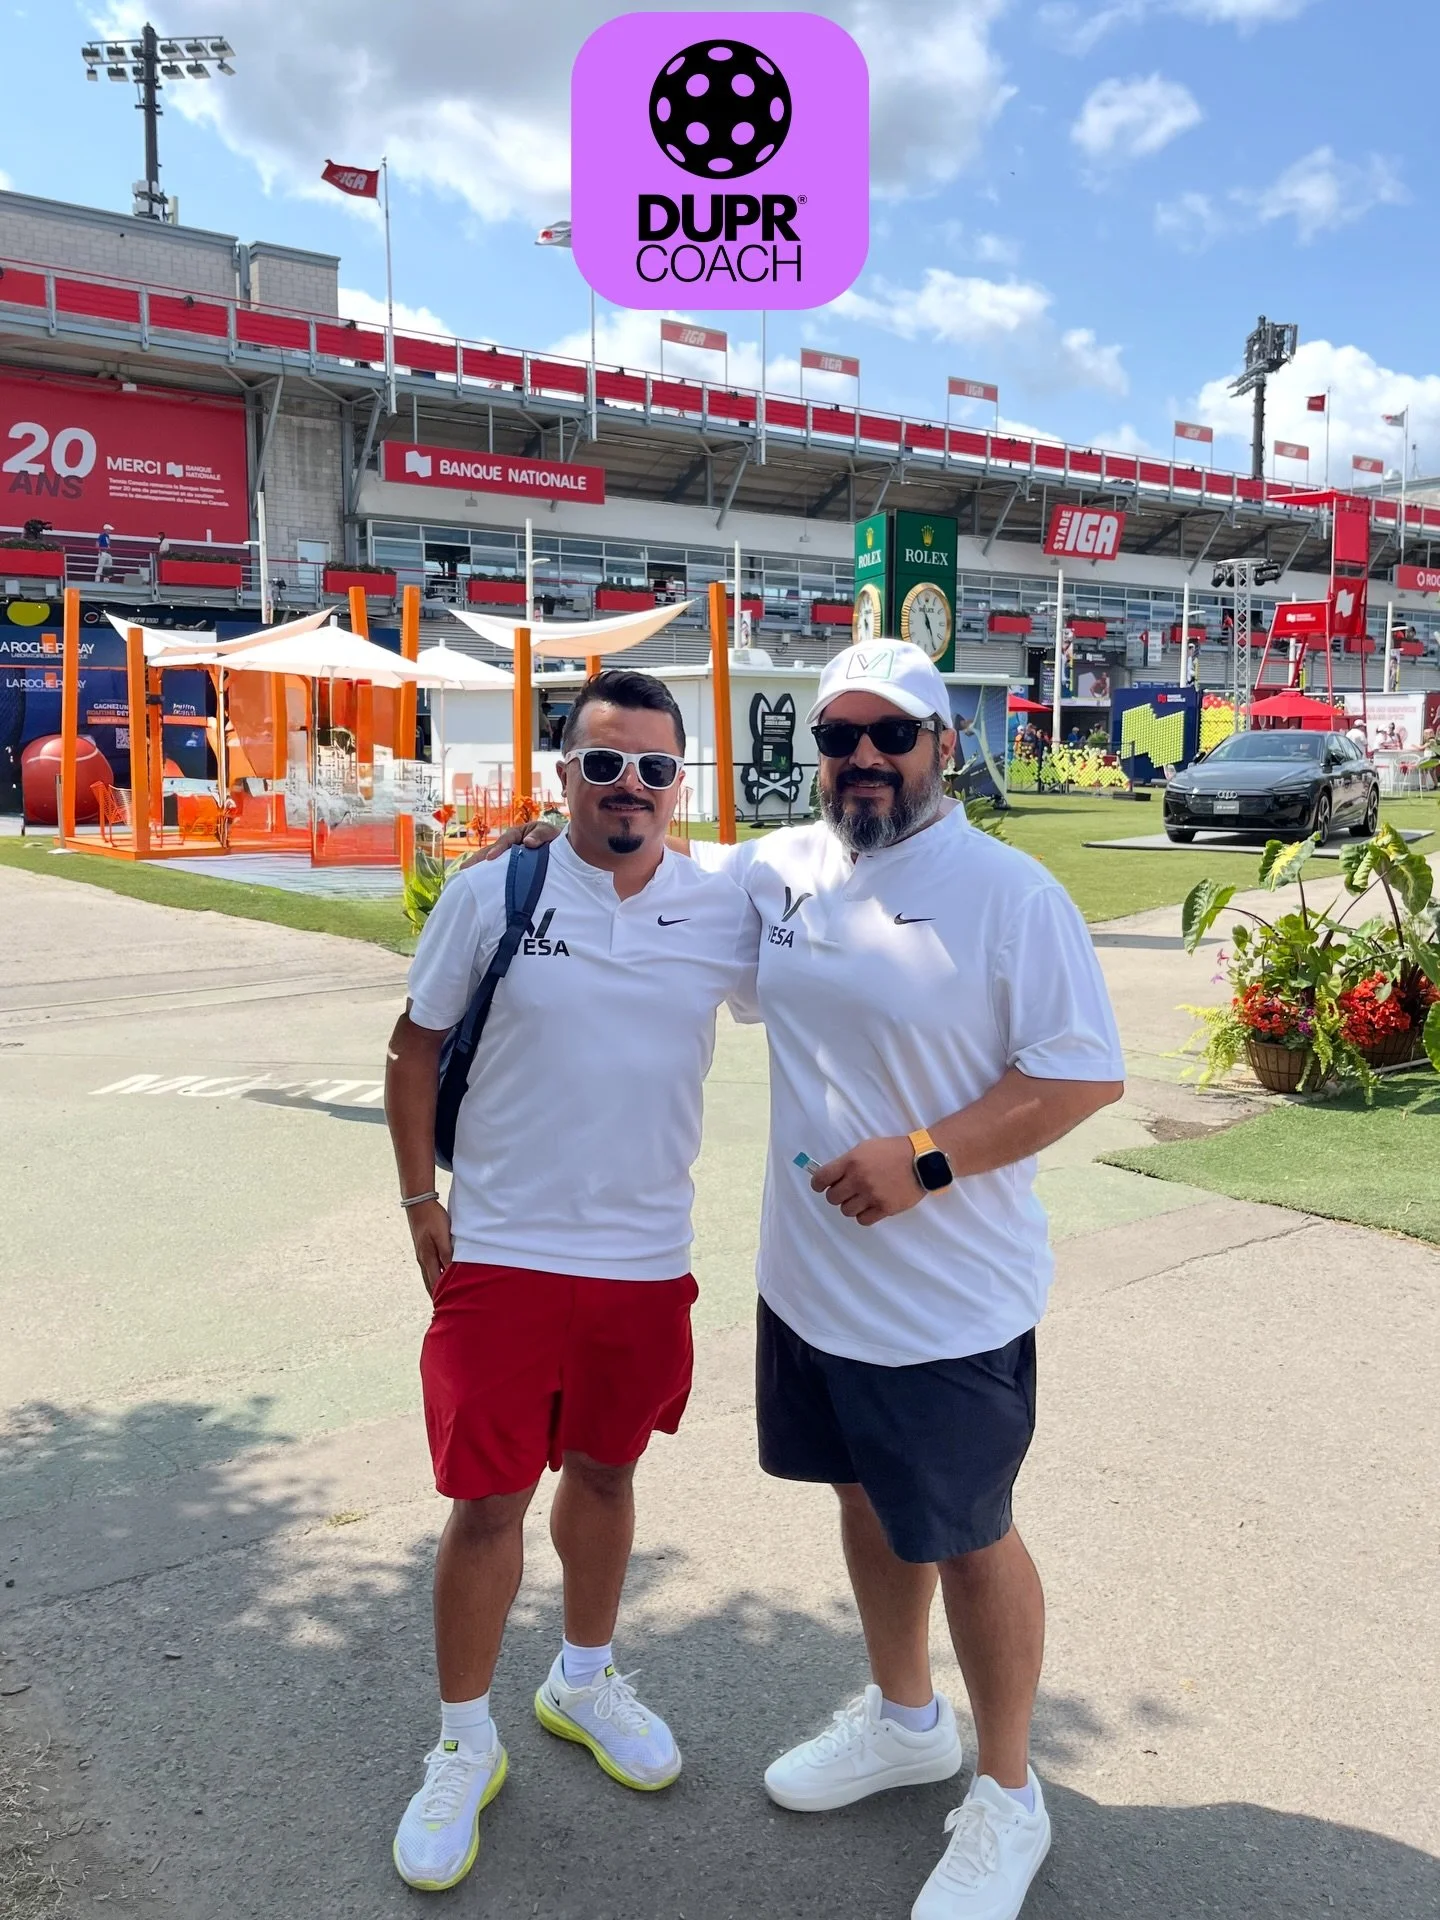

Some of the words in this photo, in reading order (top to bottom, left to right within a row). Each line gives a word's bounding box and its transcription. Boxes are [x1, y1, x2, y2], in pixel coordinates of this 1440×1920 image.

[2, 422, 97, 478] 20
[106, 456, 161, 475] MERCI
[439, 459, 502, 481] BANQUE
[508, 468, 587, 490] NATIONALE
[8, 470, 84, 499] ANS
[1053, 510, 1073, 550] STADE
[1064, 511, 1119, 555] IGA
[858, 549, 882, 568] ROLEX
[905, 548, 949, 566] ROLEX
[0, 641, 10, 652] A
[11, 642, 56, 653] ROCHE
[6, 679, 20, 688] LA
[20, 679, 56, 688] ROCHE
[523, 938, 570, 957] ESA
